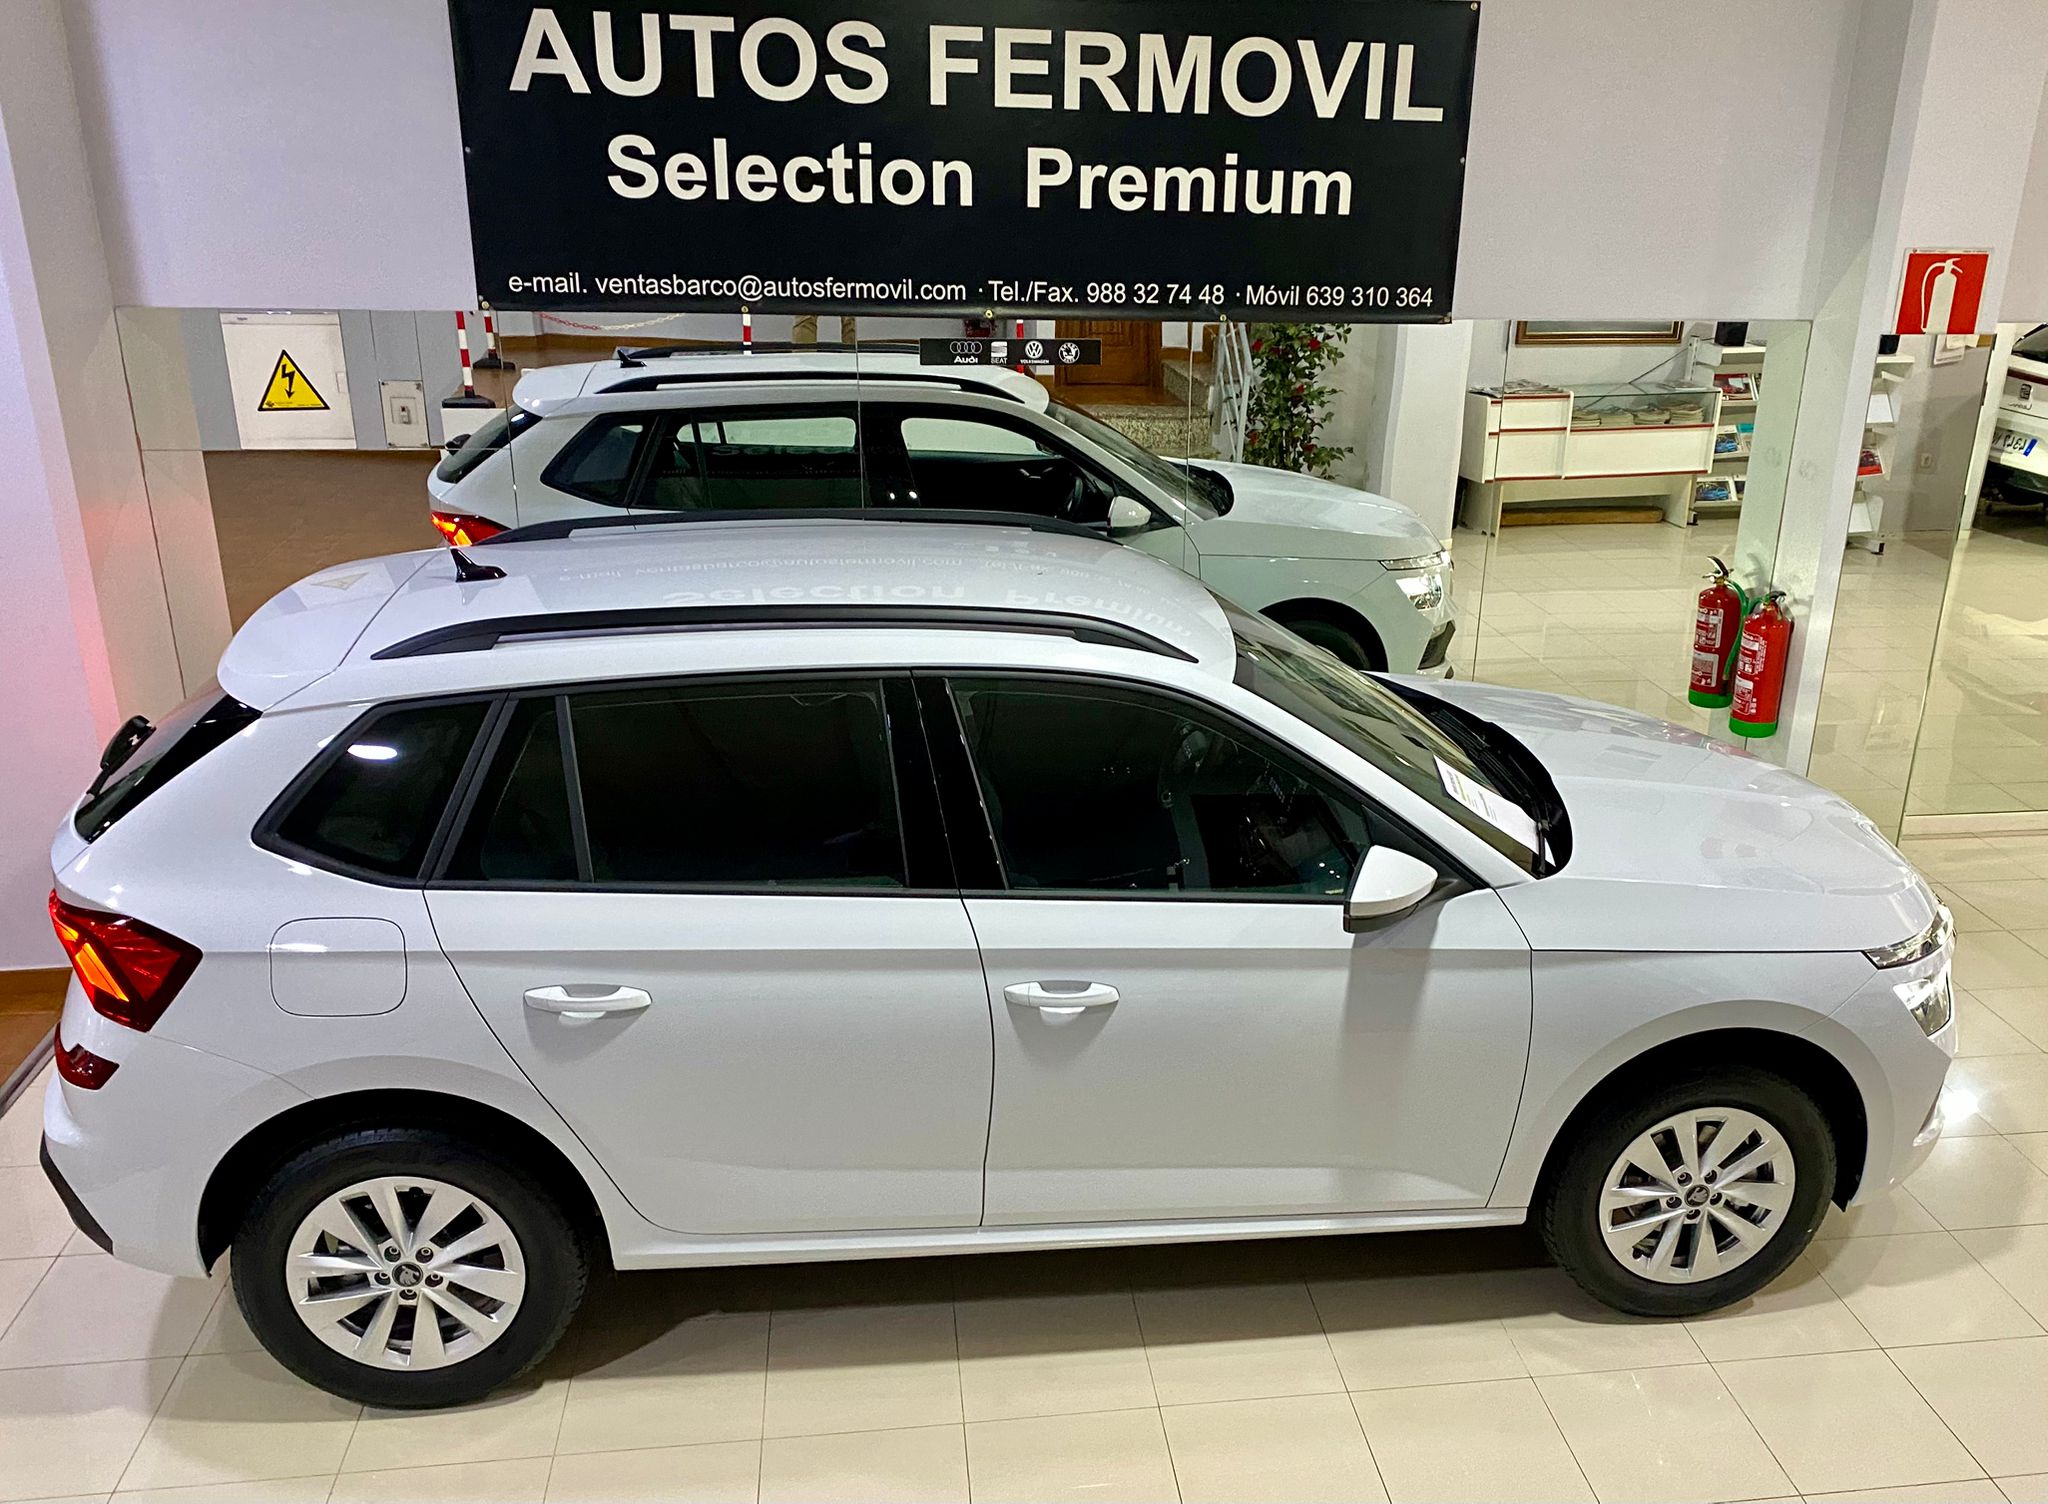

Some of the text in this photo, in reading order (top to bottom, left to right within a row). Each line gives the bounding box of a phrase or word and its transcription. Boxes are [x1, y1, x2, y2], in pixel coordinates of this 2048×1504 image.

[510, 8, 1443, 121] AUTOS FERMOVIL
[608, 135, 1351, 215] Selection Premium
[509, 272, 587, 293] e-mail.
[595, 274, 965, 301] ventasbarco@autosfermovil.com
[1087, 283, 1126, 303] 988
[1134, 283, 1159, 303] 32
[1167, 284, 1191, 304] 74
[1199, 284, 1224, 304] 48
[1246, 285, 1299, 305] Móvil
[1307, 286, 1344, 306] 639
[1352, 287, 1389, 306] 310
[1396, 287, 1432, 307] 364
[953, 355, 979, 364] Audi
